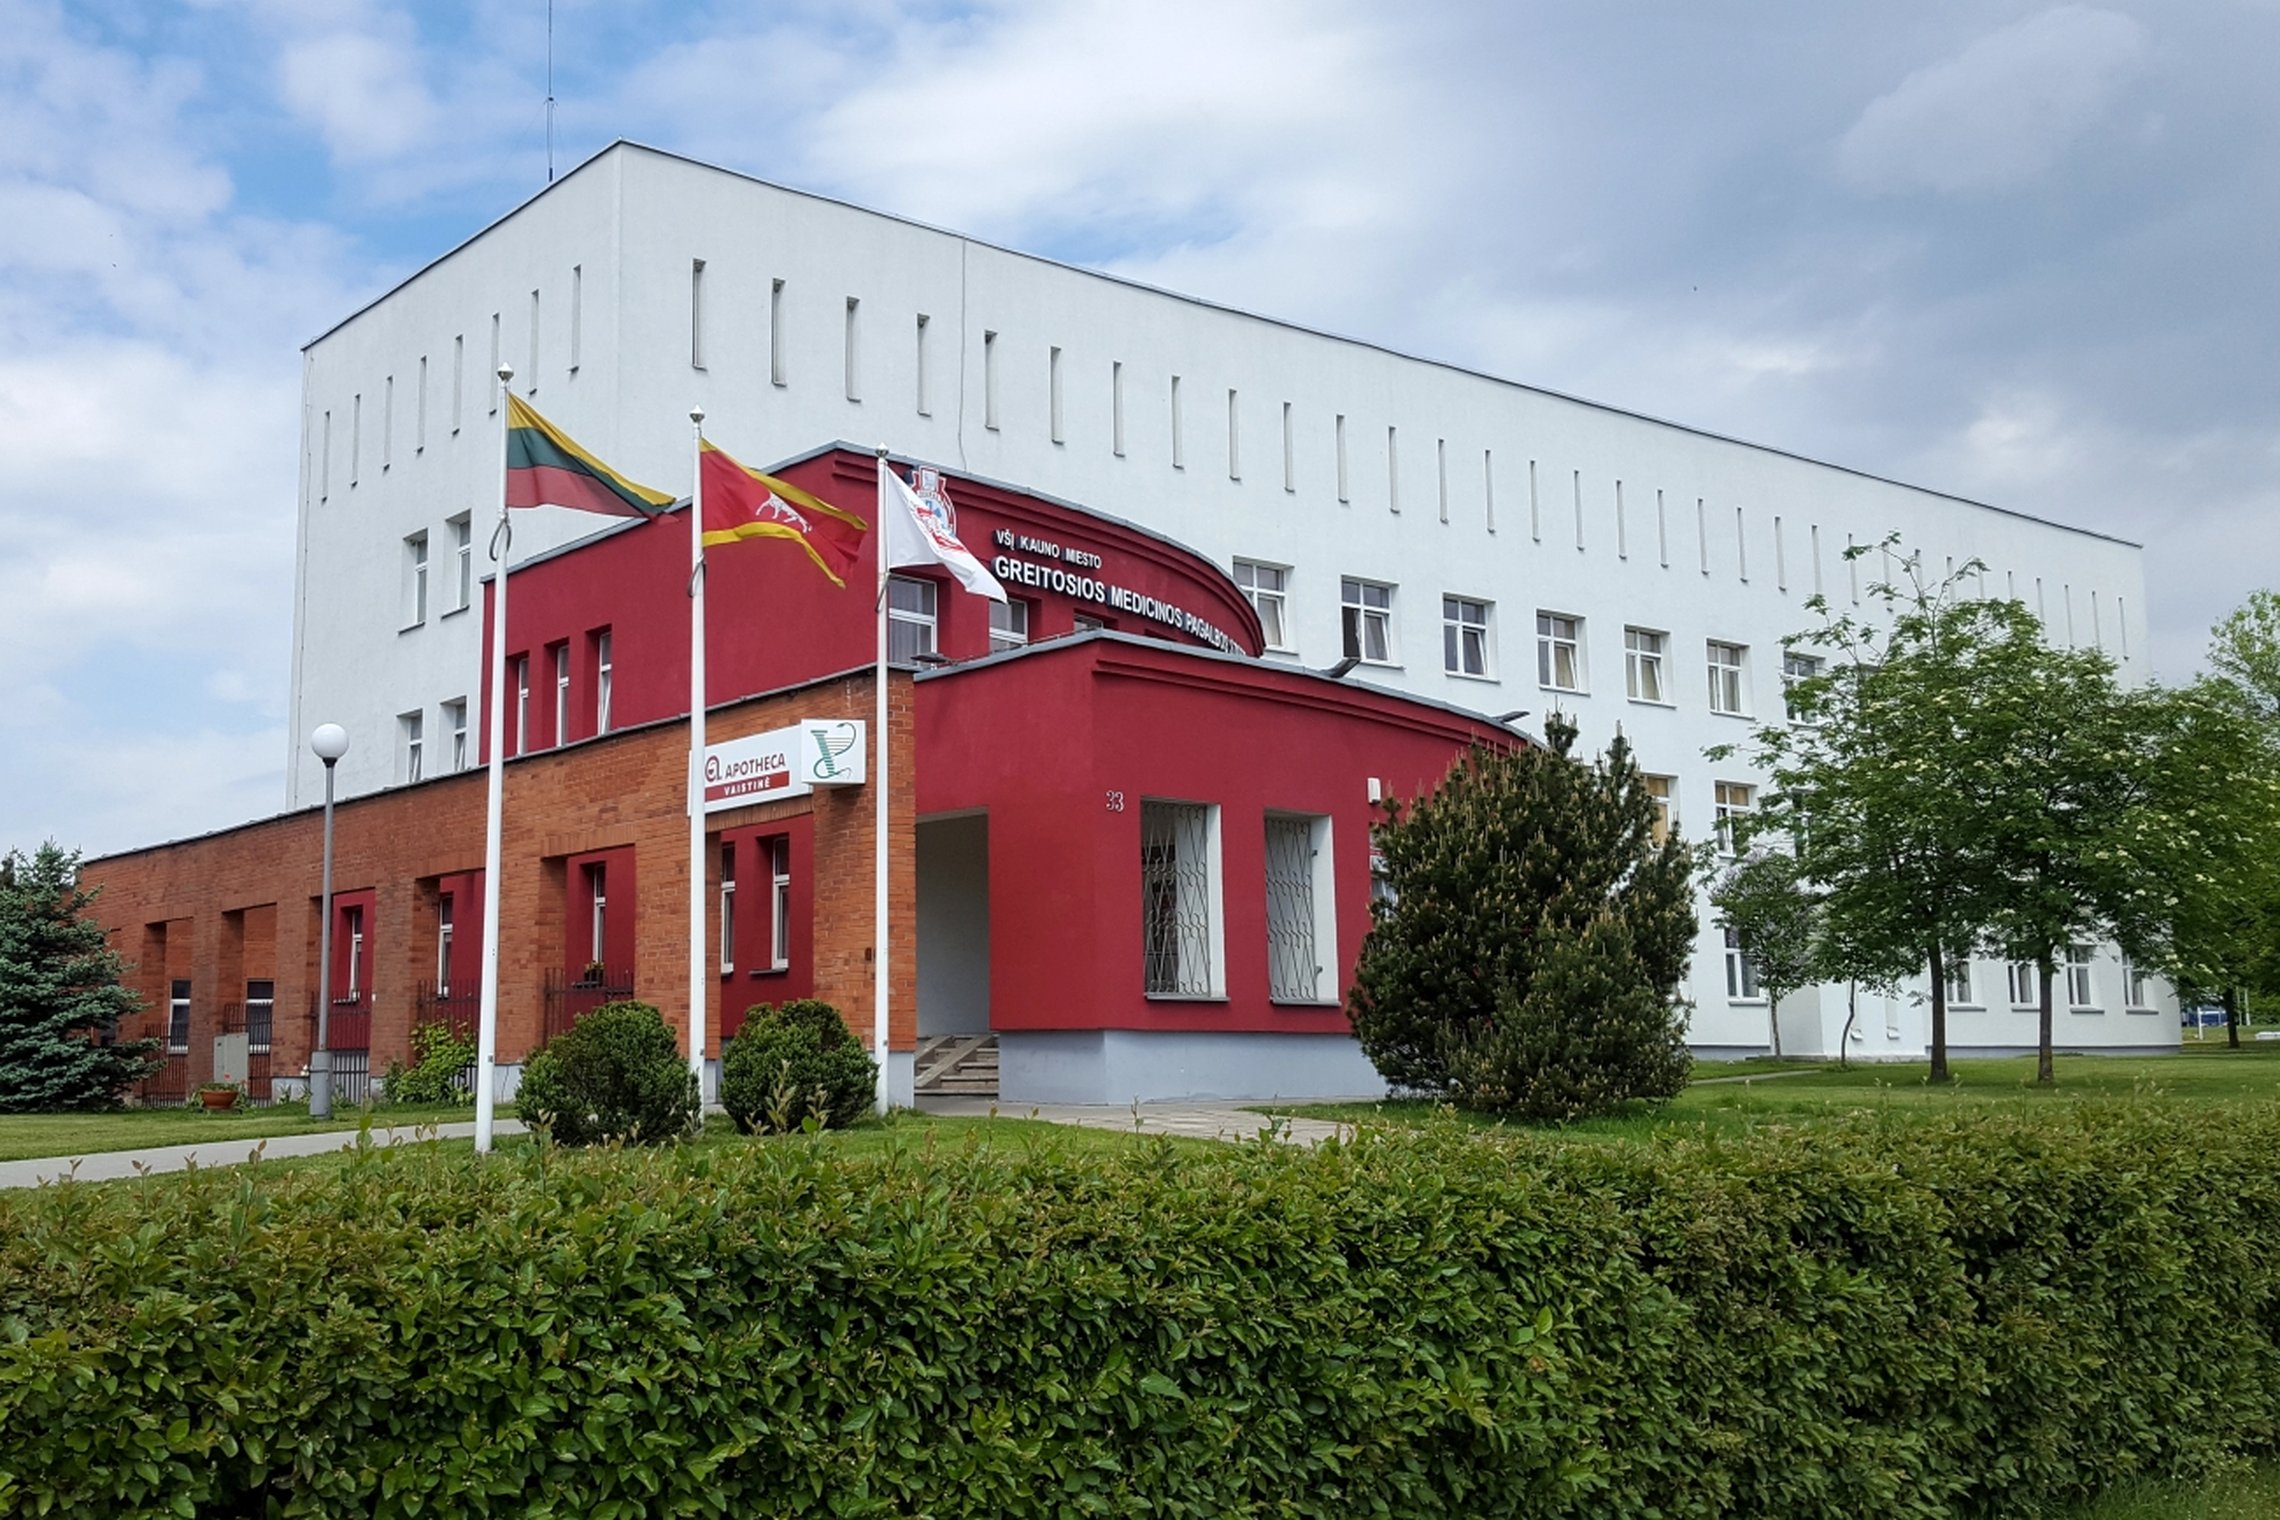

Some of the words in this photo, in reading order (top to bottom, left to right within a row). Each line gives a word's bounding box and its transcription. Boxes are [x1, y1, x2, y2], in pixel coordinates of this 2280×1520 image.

[1020, 536, 1060, 558] KAUNO
[995, 555, 1105, 603] GREITOSIOS
[1111, 584, 1183, 628] MEDICINOS
[725, 752, 786, 779] APOTHECA
[724, 776, 771, 796] VAISTINĖ
[1105, 790, 1124, 812] 33
